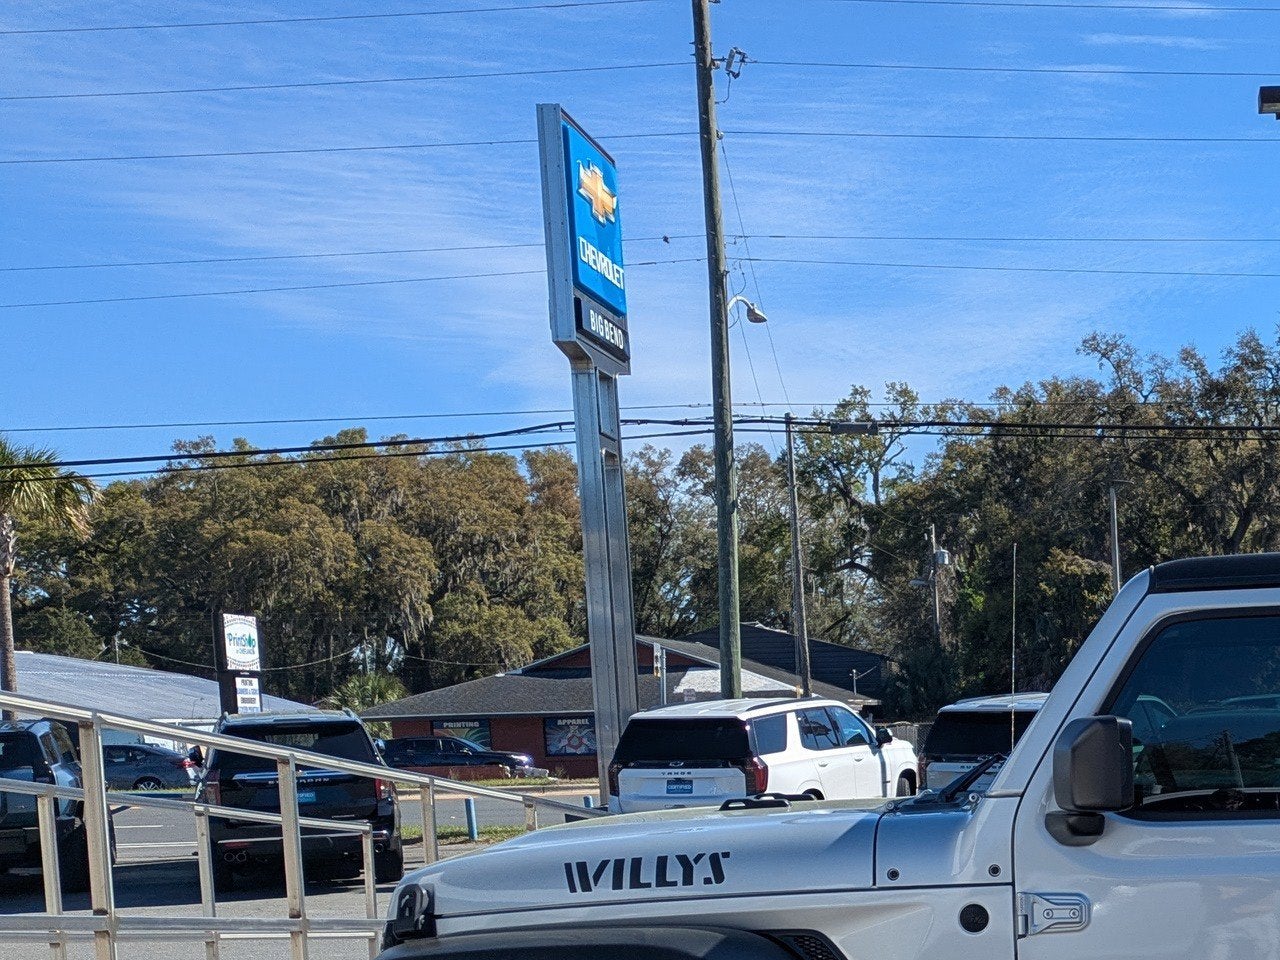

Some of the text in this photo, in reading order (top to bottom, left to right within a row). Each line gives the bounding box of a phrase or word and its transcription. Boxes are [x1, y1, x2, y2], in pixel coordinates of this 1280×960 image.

[579, 236, 625, 290] CHEVROLET
[590, 309, 624, 350] BIG BEND
[557, 718, 590, 726] APPAREL
[564, 851, 731, 893] WILLYS
